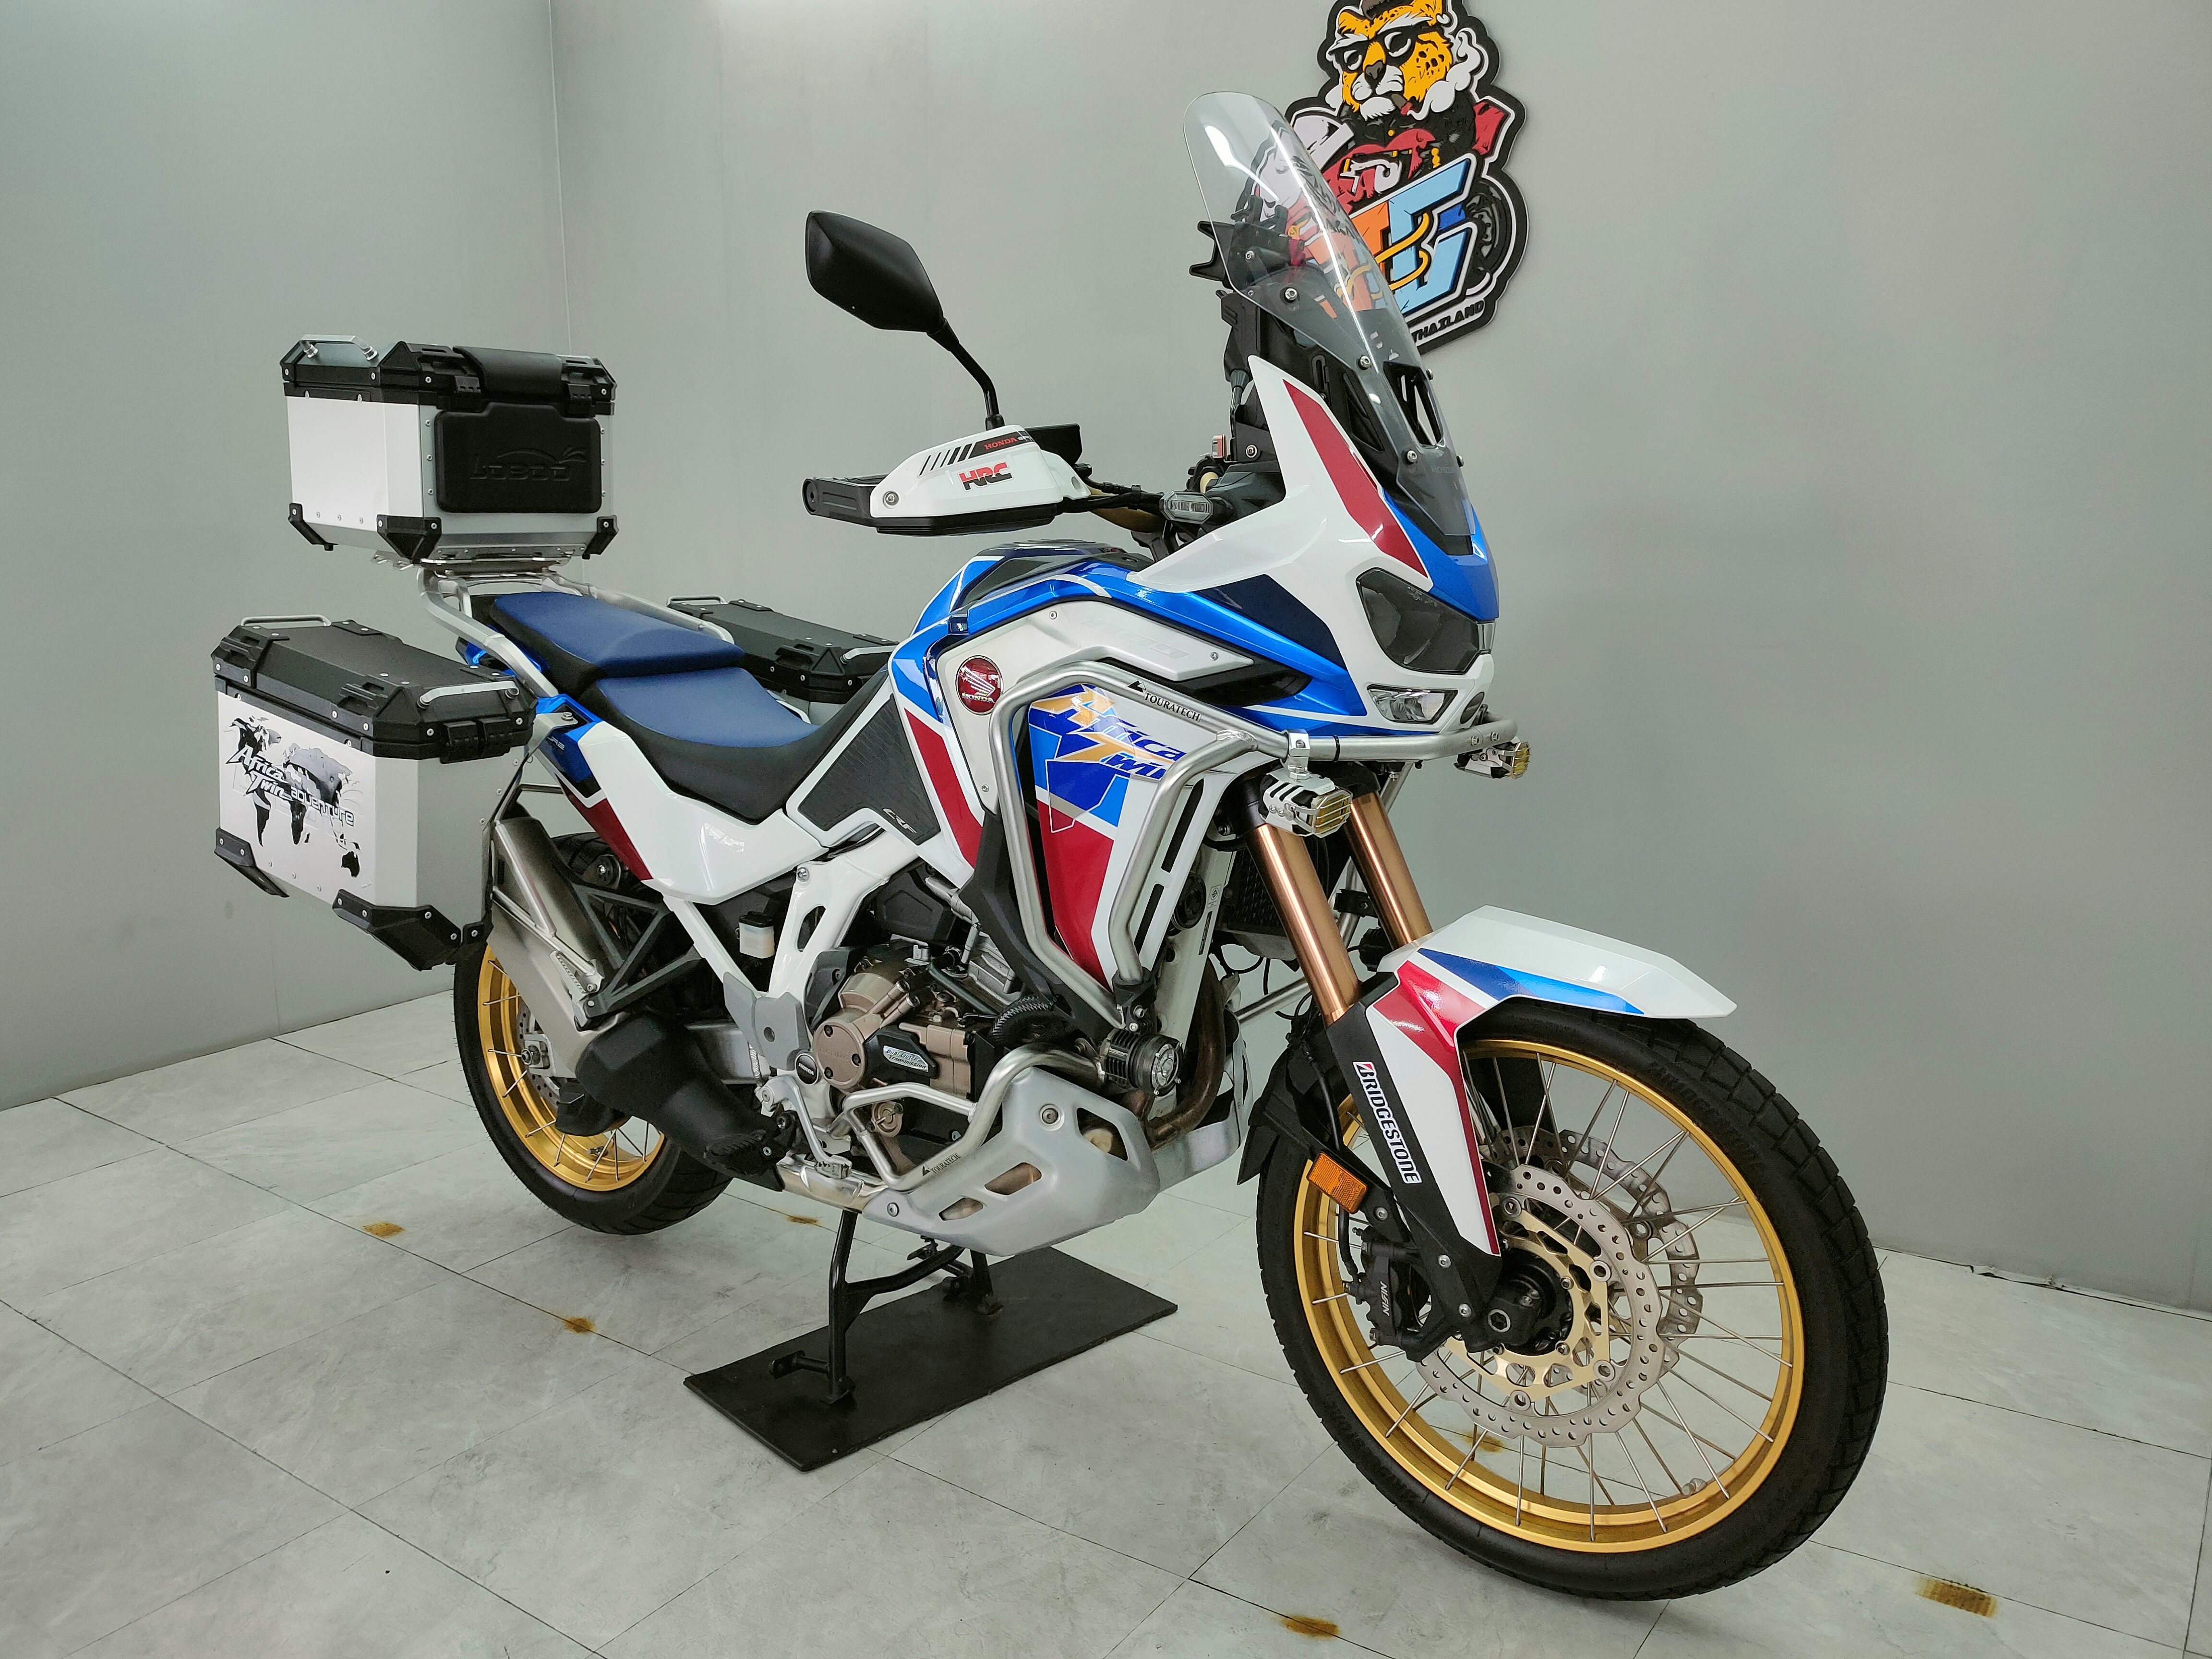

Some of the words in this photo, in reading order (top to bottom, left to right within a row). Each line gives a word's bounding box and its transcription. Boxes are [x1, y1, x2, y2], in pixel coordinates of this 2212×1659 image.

[1411, 300, 1485, 343] THAILAND
[985, 437, 1018, 450] HONDA
[959, 461, 1013, 491] HRC
[962, 691, 995, 704] HONDA
[1144, 692, 1201, 722] TOURATECH
[225, 744, 287, 782] Africa
[244, 770, 292, 802] Twin
[882, 808, 918, 834] CRF
[886, 1049, 900, 1057] Dual
[888, 1055, 926, 1069] Transmission
[798, 1062, 815, 1076] HONDA
[1355, 1063, 1420, 1183] BRIDGESTONE
[931, 1153, 961, 1174] TOURATECH
[1380, 1280, 1390, 1317] NISSIN
